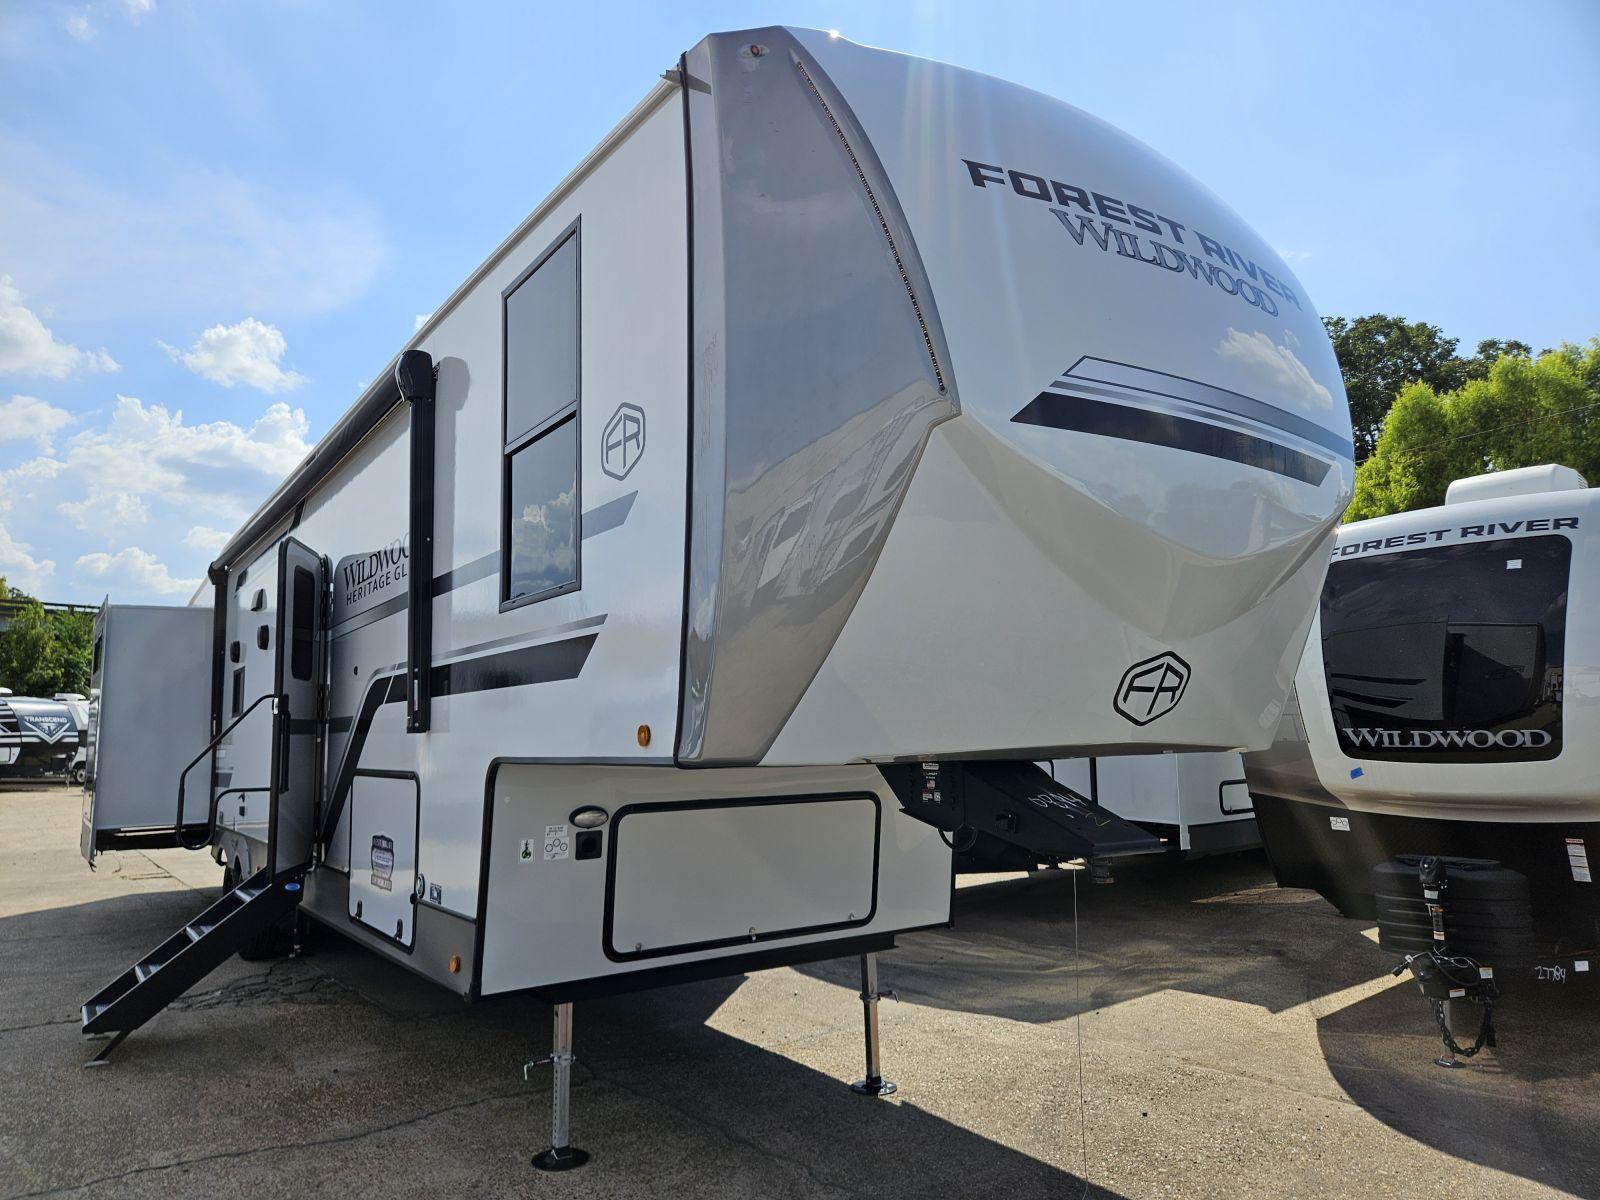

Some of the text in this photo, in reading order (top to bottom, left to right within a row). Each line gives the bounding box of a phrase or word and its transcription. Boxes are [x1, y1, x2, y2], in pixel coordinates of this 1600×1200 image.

[961, 159, 1303, 312] FOREST RIVER
[1048, 207, 1279, 318] WILDWOOD
[1460, 517, 1579, 538] RIVER
[346, 571, 391, 606] HERITAGE
[24, 715, 68, 723] TRANSCEND
[1342, 727, 1552, 748] WILDWOOD
